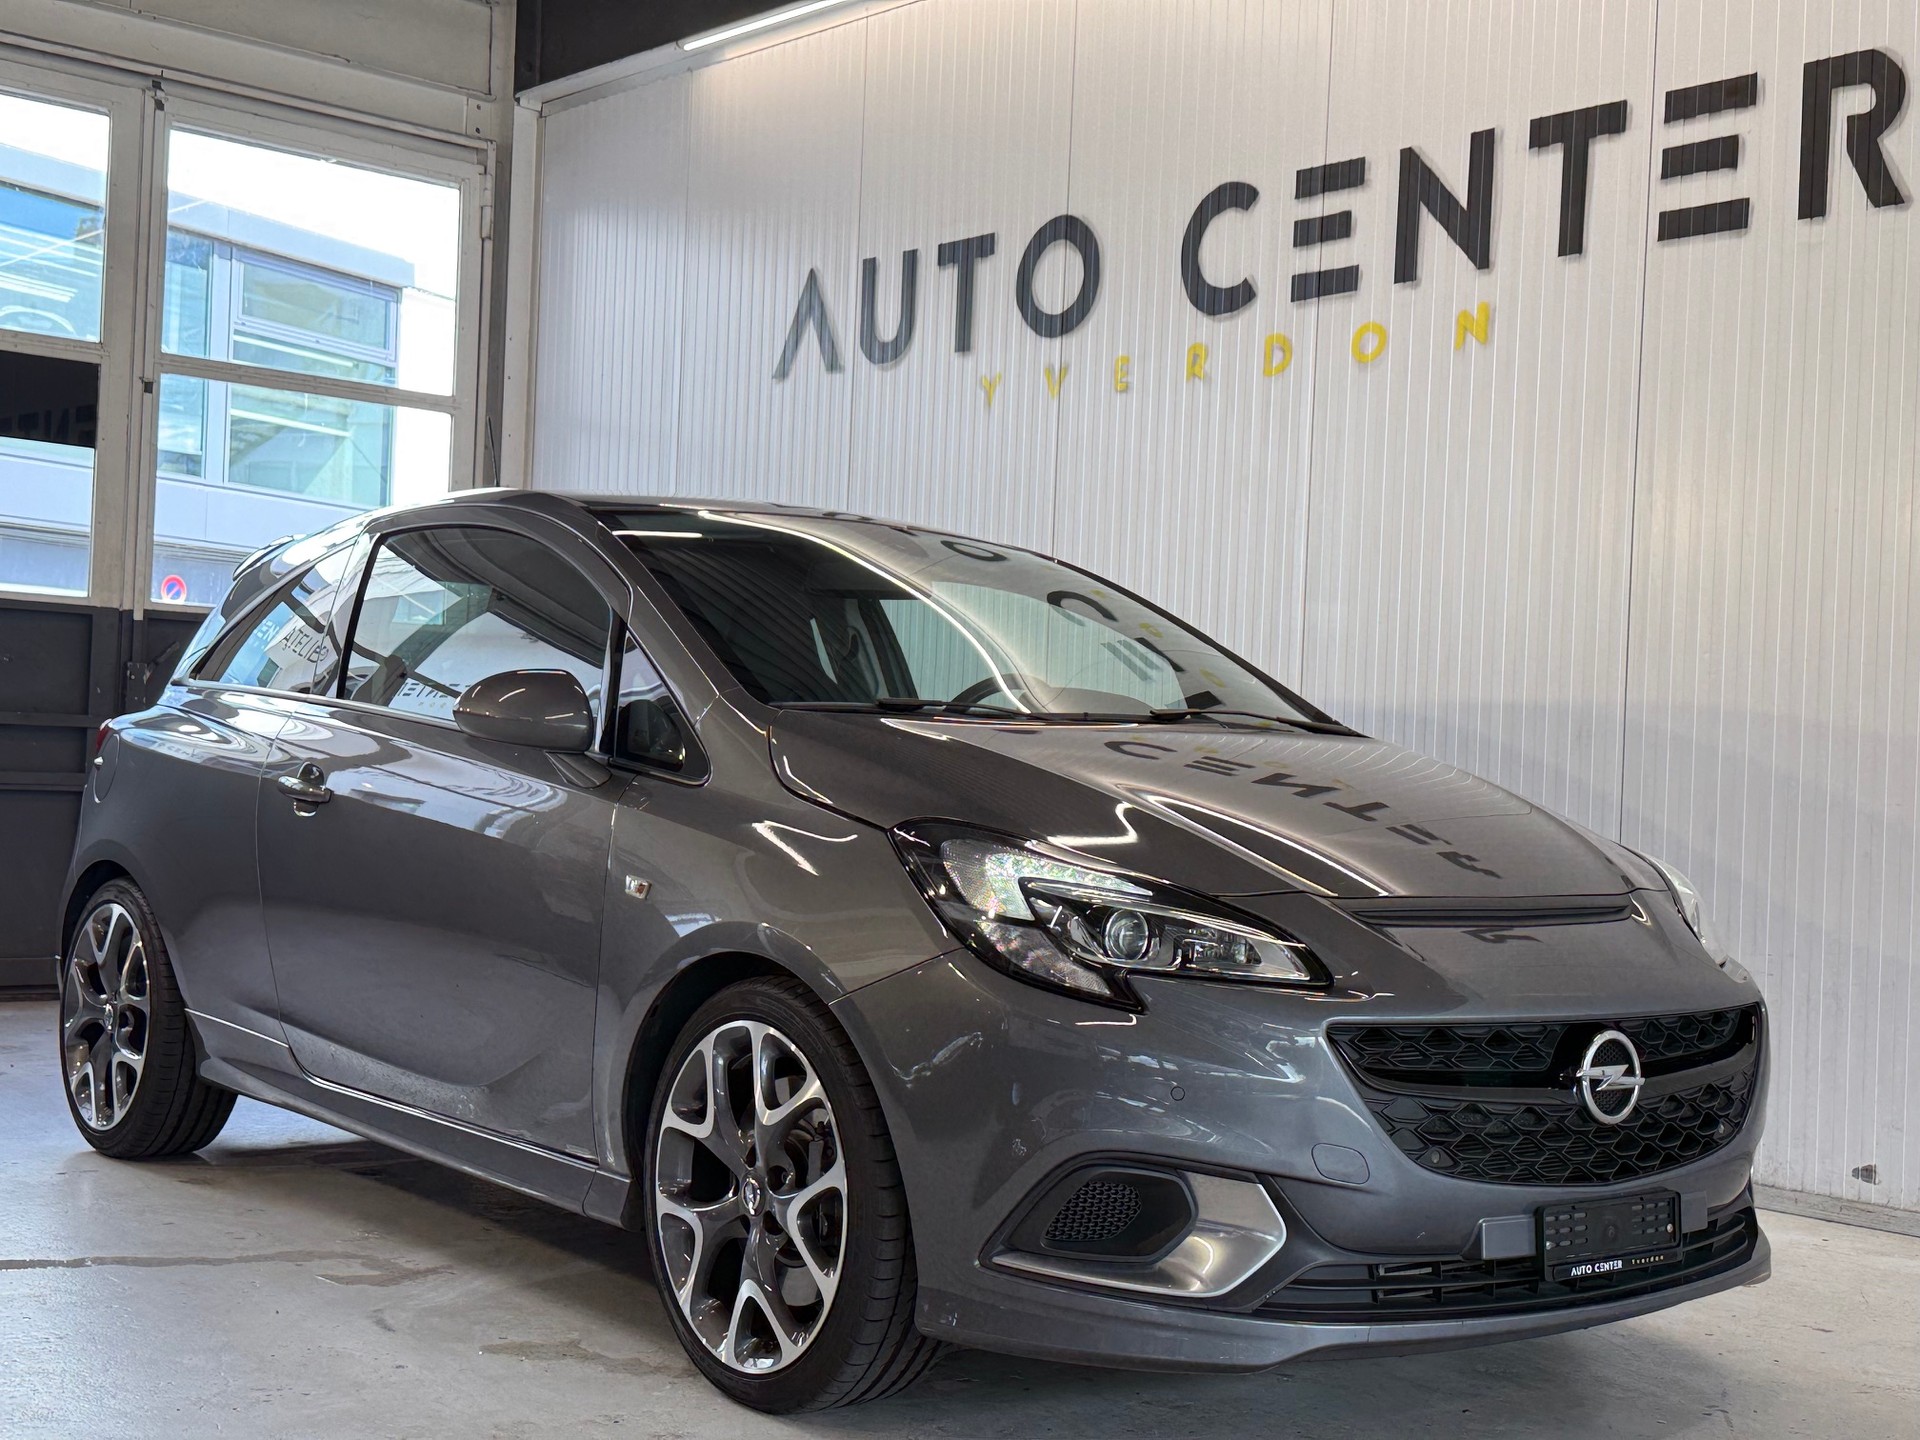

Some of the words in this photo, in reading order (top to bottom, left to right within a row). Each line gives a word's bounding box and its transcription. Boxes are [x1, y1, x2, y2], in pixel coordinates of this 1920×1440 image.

[772, 214, 1100, 382] AUTO
[1181, 48, 1906, 316] CENTER
[981, 302, 1489, 407] YVERDON
[1570, 1264, 1593, 1277] AUTO
[1594, 1259, 1623, 1272] CENTER
